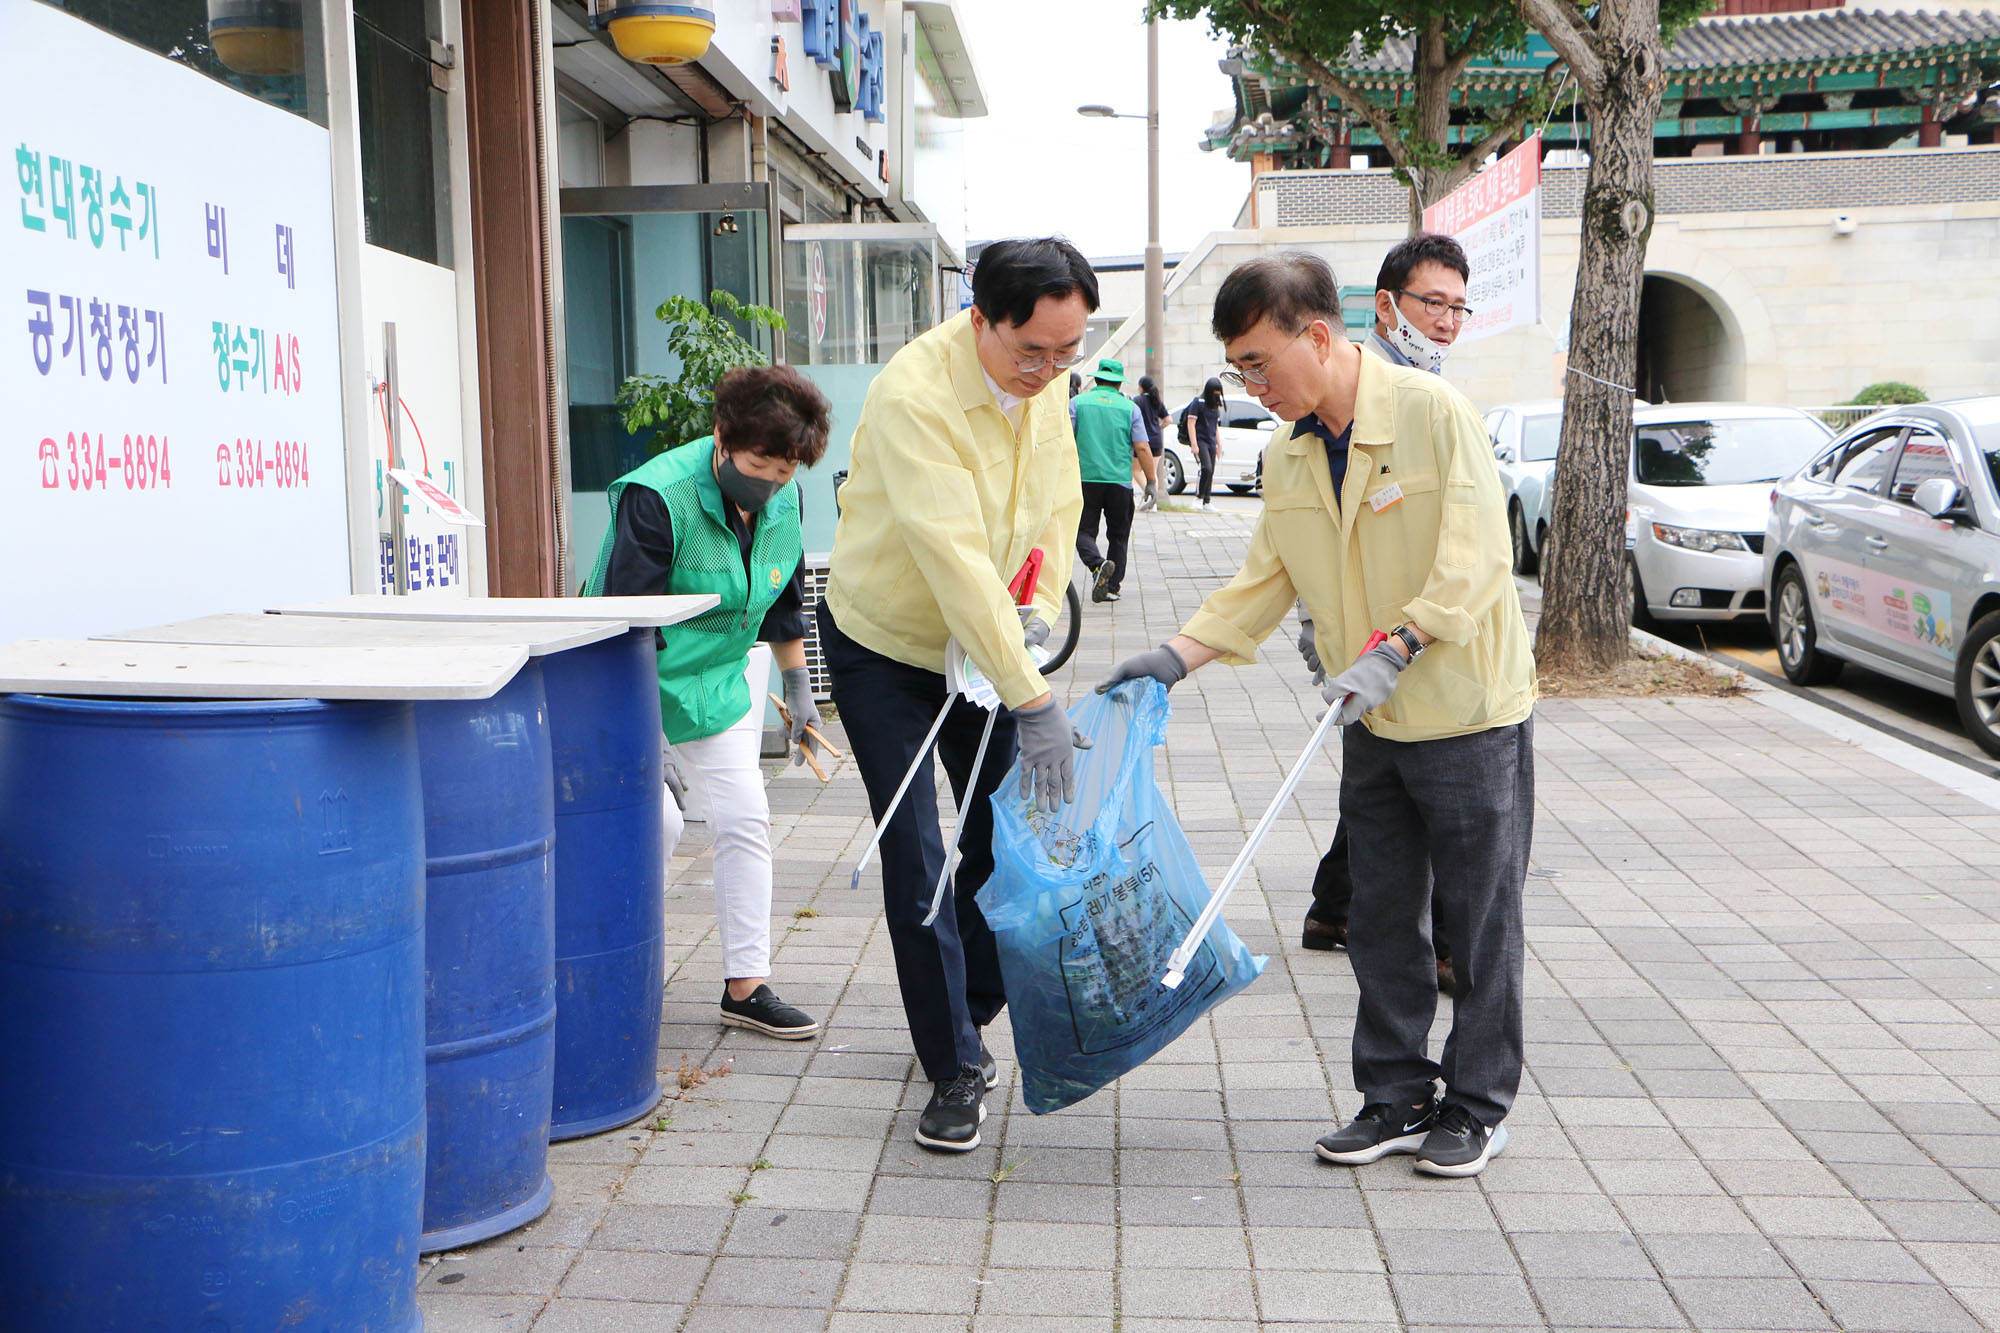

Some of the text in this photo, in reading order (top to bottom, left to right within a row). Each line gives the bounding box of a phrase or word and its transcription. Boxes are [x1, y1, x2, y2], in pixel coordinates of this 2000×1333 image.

[15, 142, 160, 260] 현대정수기
[26, 289, 168, 385] 공기청정기
[212, 321, 301, 396] 정수기 A/S
[67, 431, 171, 491] 334-8894
[236, 438, 309, 488] 334-8894
[425, 543, 435, 588] 및
[437, 533, 460, 587] 판매
